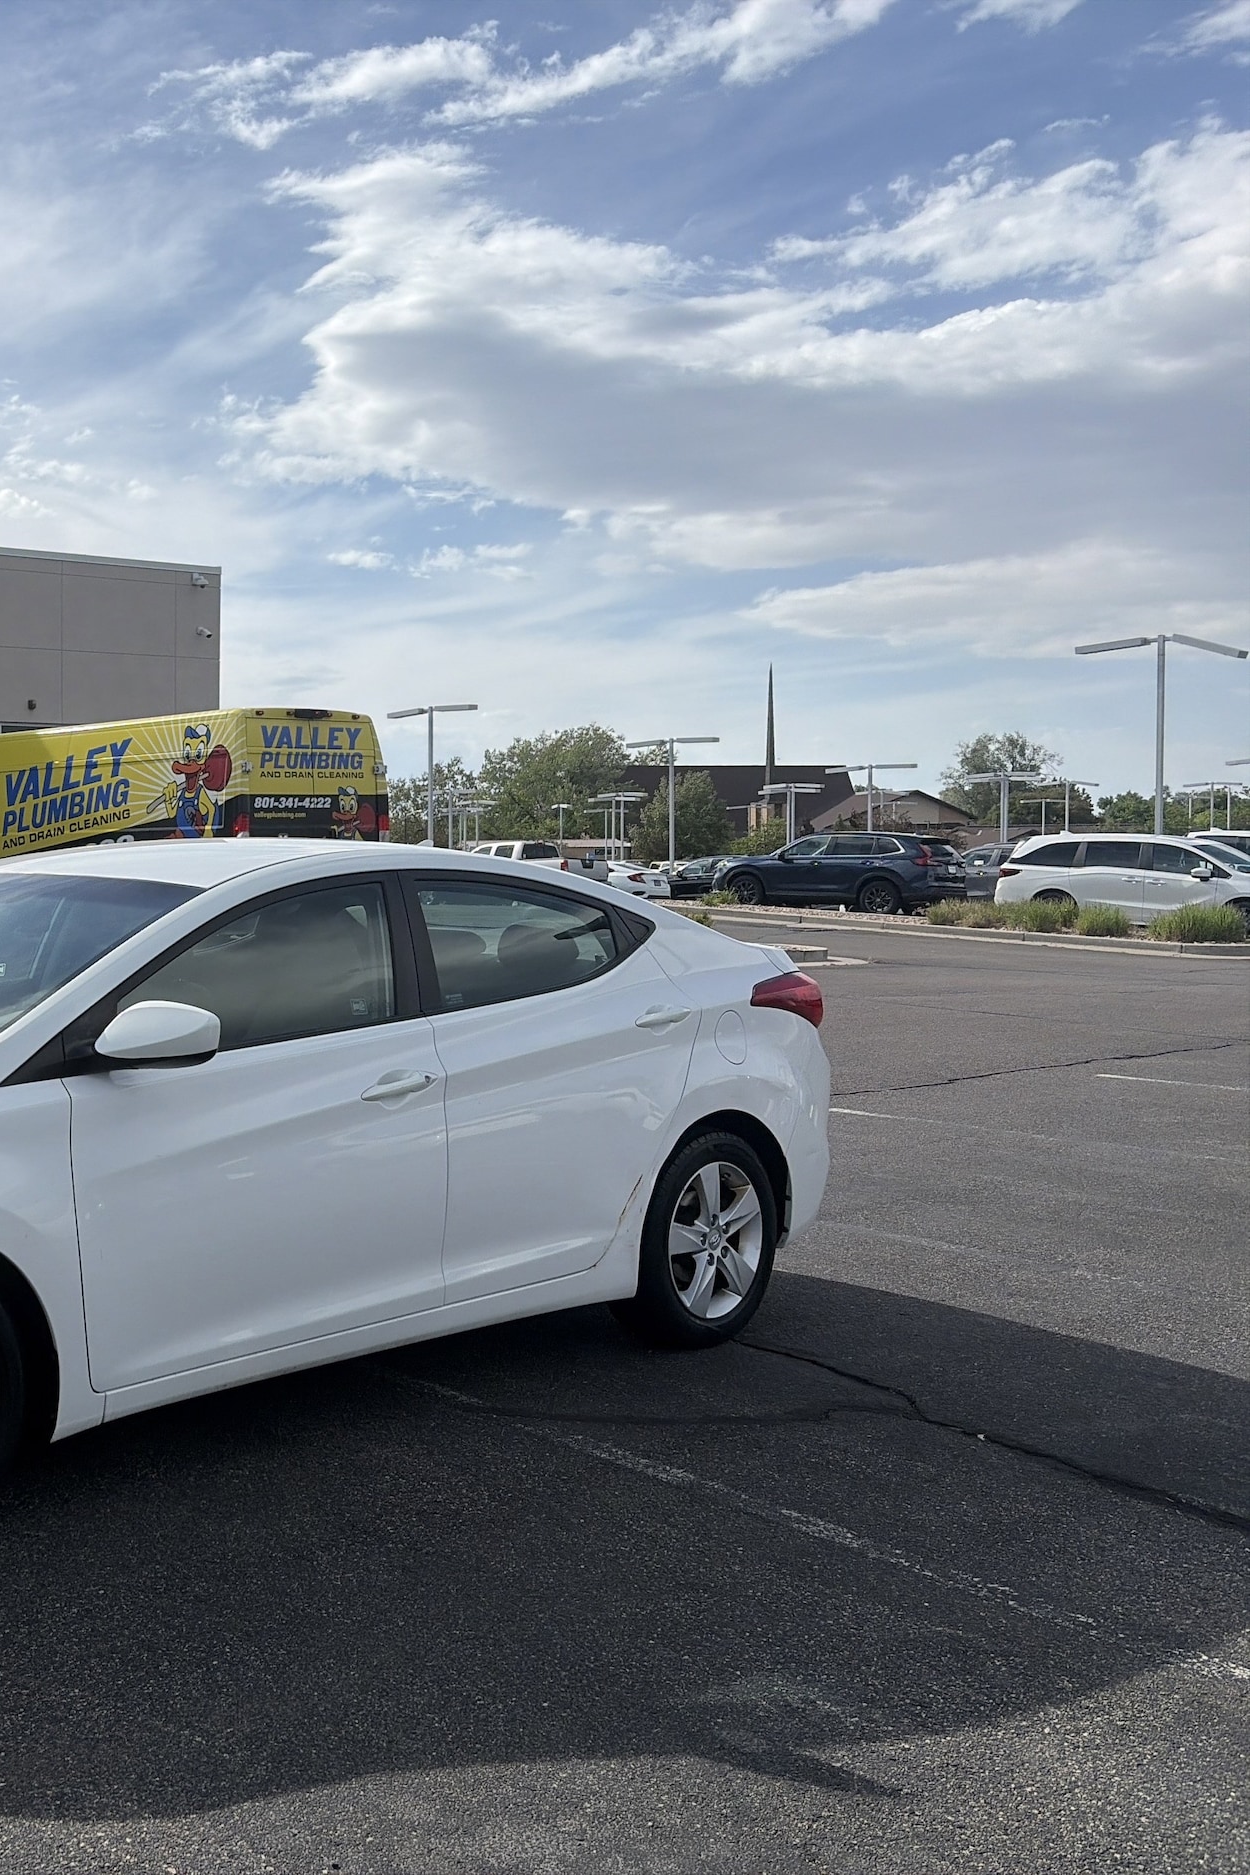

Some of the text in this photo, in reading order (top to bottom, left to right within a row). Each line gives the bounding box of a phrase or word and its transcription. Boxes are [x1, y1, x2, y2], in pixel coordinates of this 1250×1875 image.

[260, 725, 362, 750] VALLEY
[5, 737, 133, 807] VALLEY
[259, 751, 363, 770] PLUMBING
[317, 771, 364, 779] CLEANING
[1, 778, 130, 837] PLUMBING
[253, 797, 332, 809] 801-341-4222
[2, 835, 26, 850] AND
[29, 825, 65, 843] DRAIN
[69, 809, 130, 832] CLEANING
